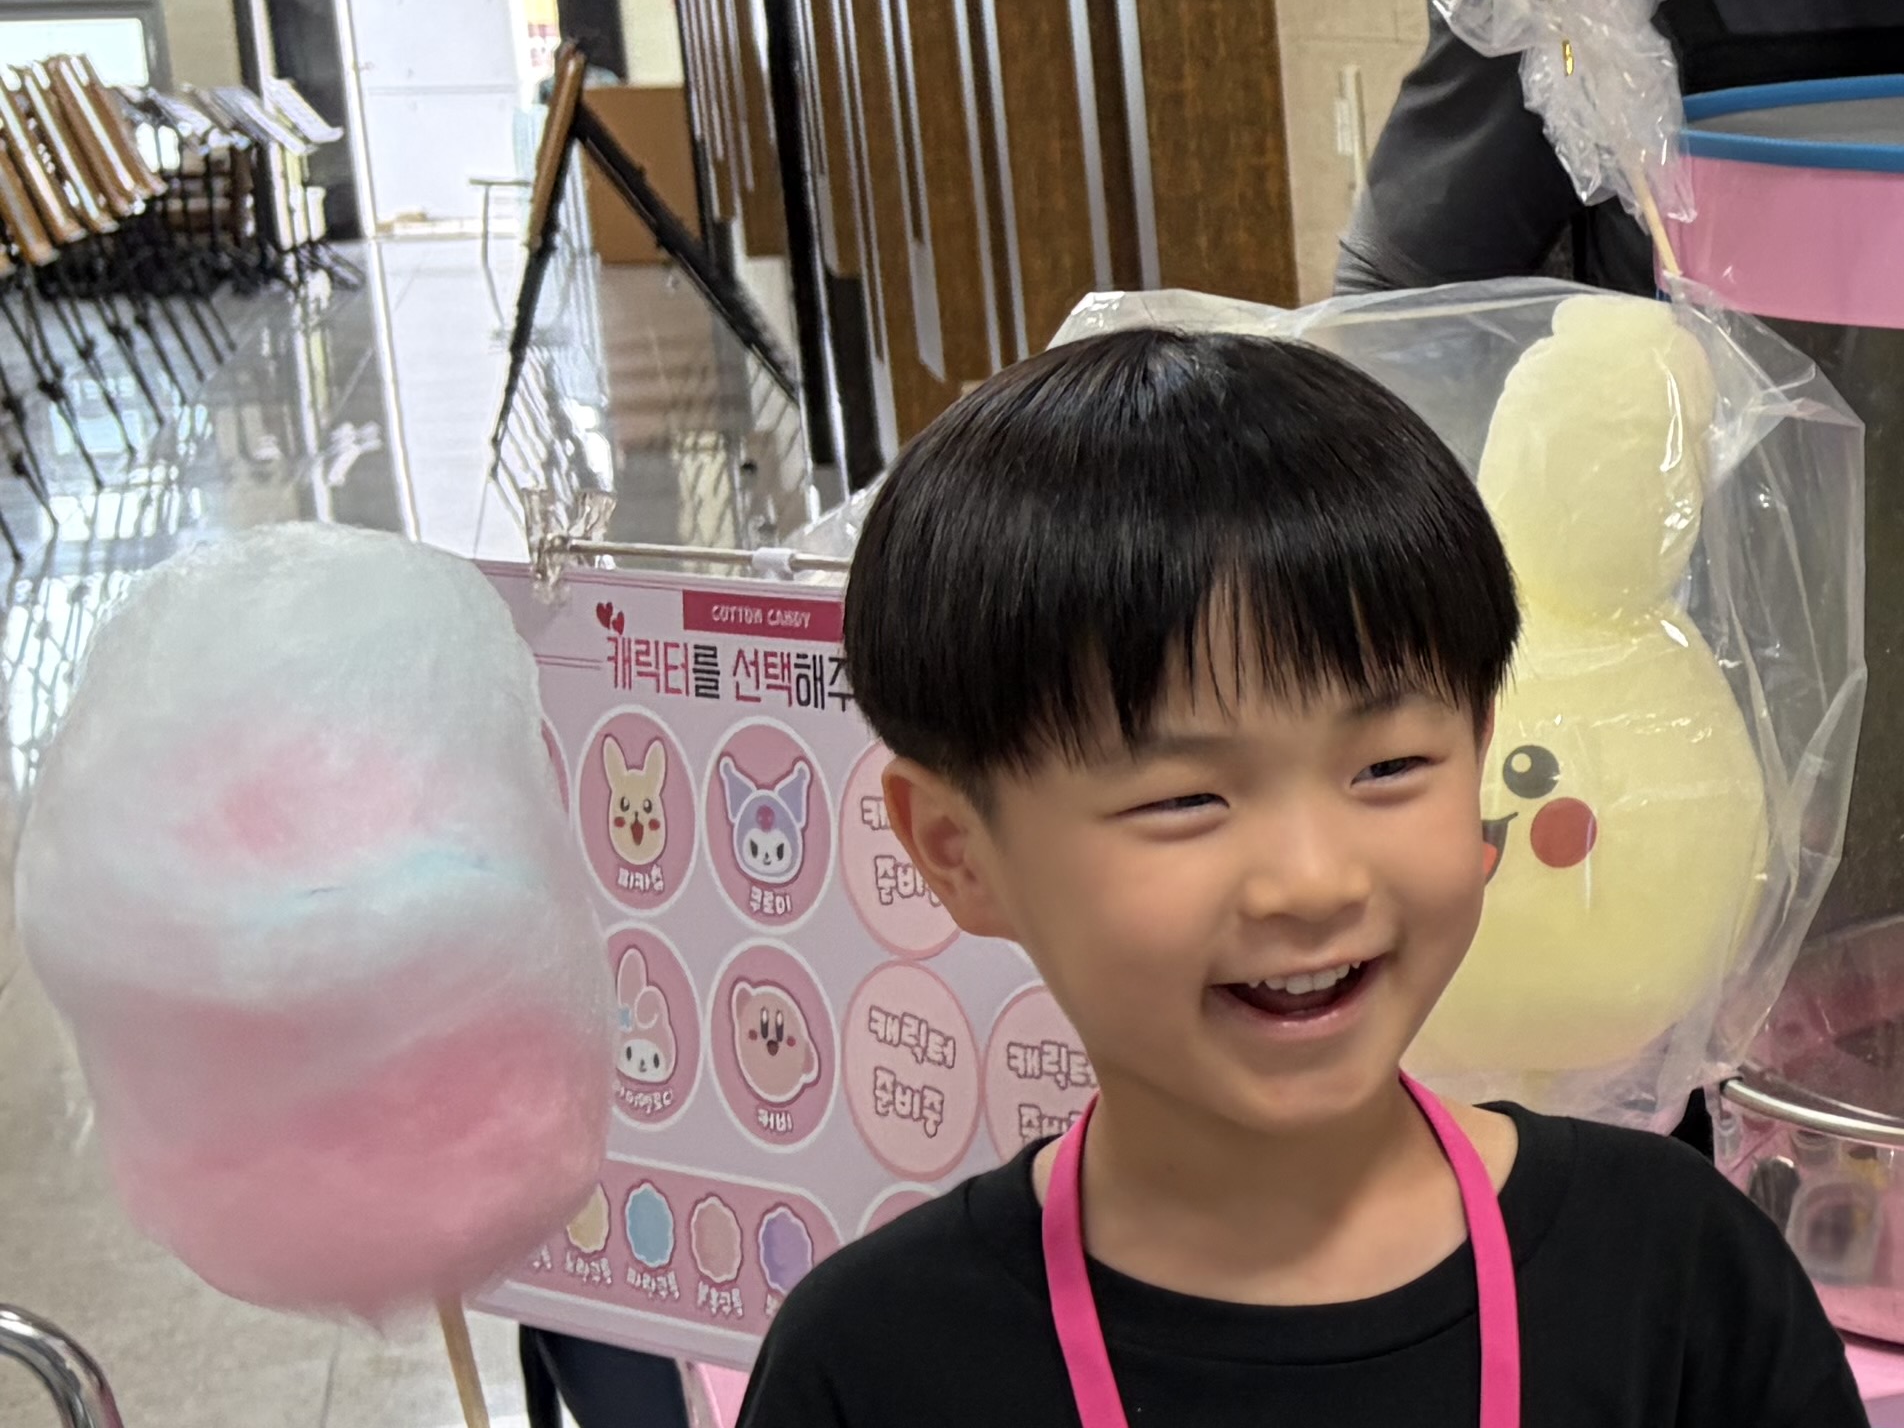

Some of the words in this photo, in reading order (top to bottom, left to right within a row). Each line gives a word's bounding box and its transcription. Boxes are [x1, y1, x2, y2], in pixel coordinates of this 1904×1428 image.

[711, 605, 763, 624] COTTON
[767, 608, 812, 630] CANDY
[607, 636, 721, 700] 캐릭터를
[874, 855, 942, 907] 준비
[868, 1005, 957, 1070] 캐릭터
[873, 1066, 945, 1139] 준비중
